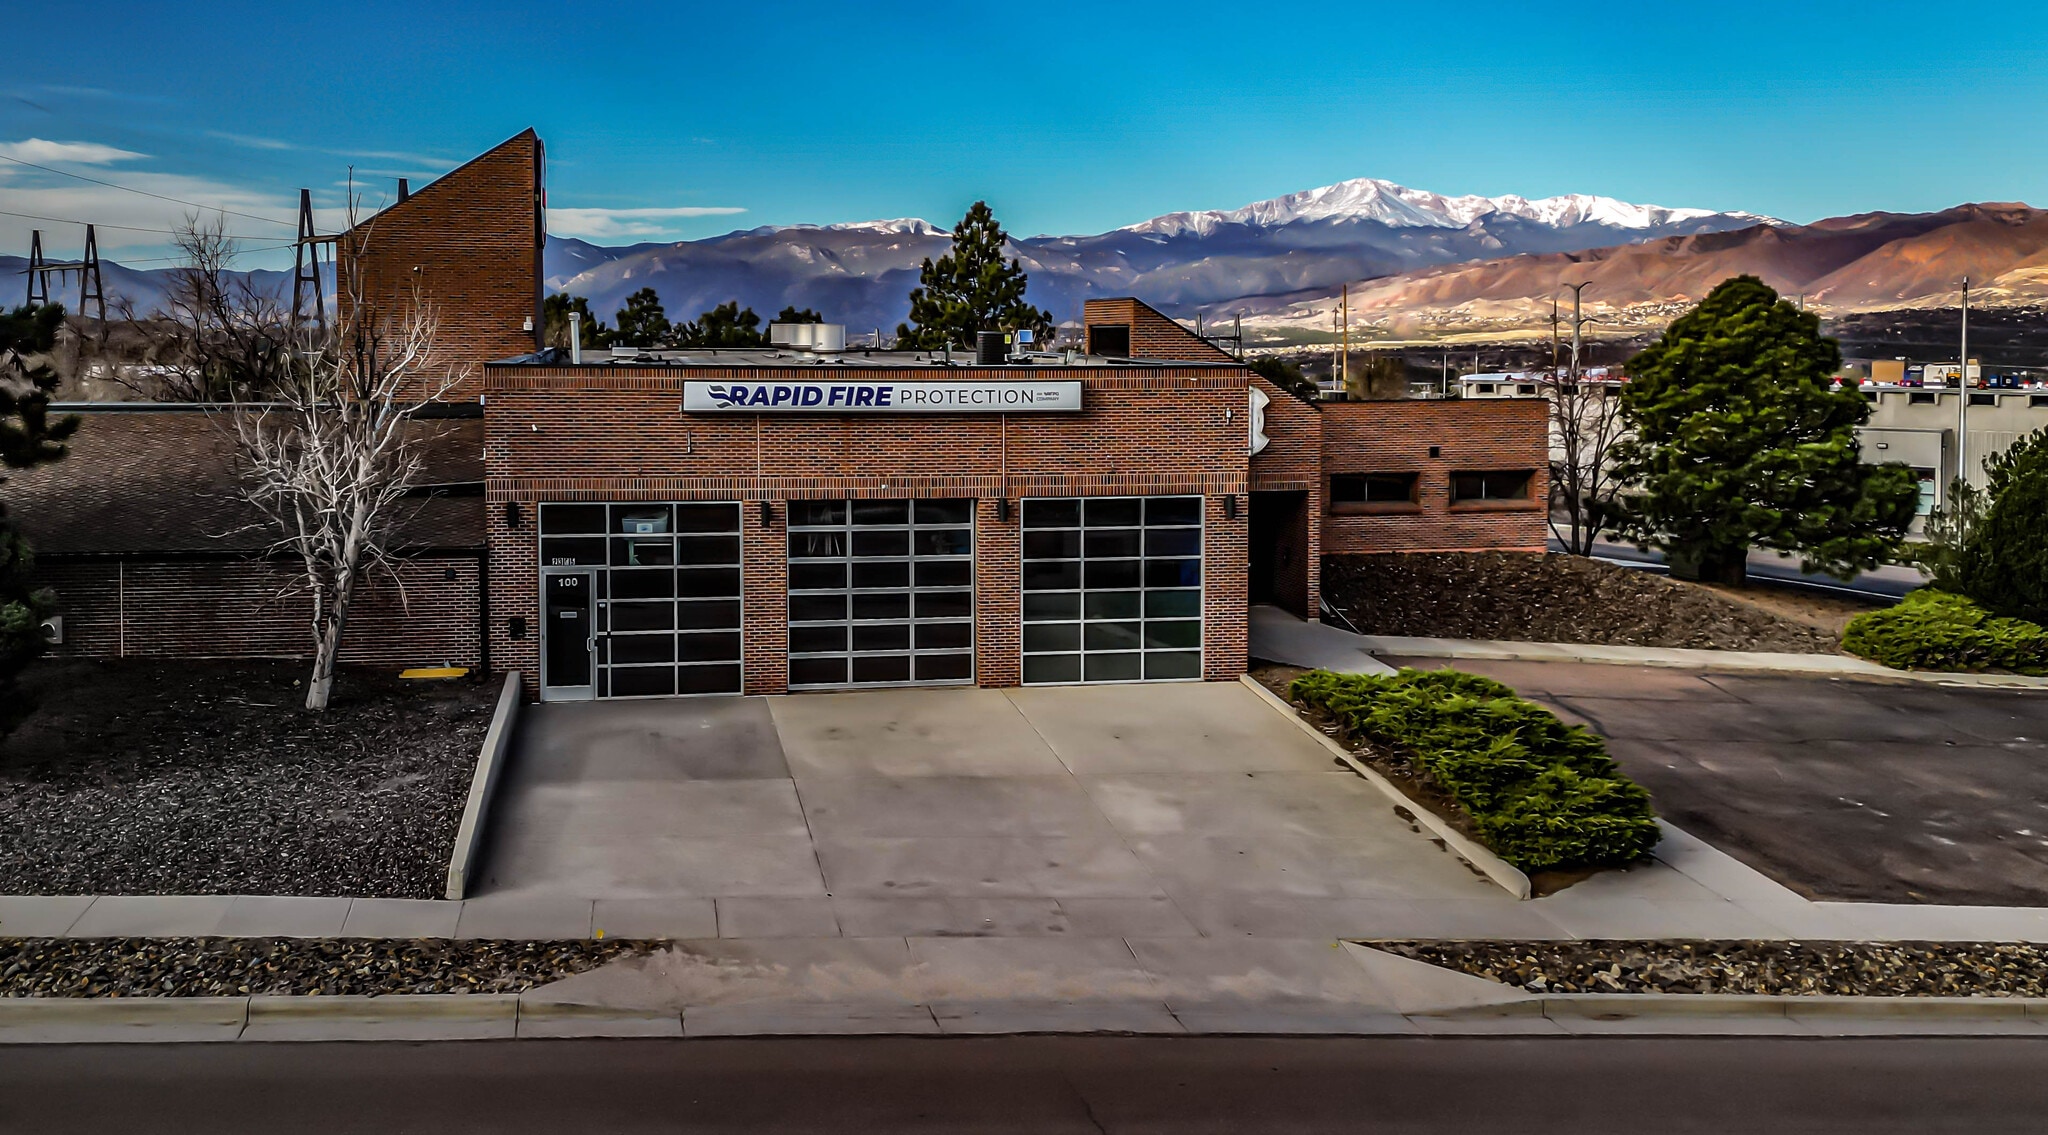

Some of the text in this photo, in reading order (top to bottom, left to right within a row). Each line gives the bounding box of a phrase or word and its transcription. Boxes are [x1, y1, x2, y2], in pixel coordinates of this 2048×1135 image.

[729, 386, 1035, 407] RAPID FIRE PROTECTION
[558, 577, 578, 587] 100
